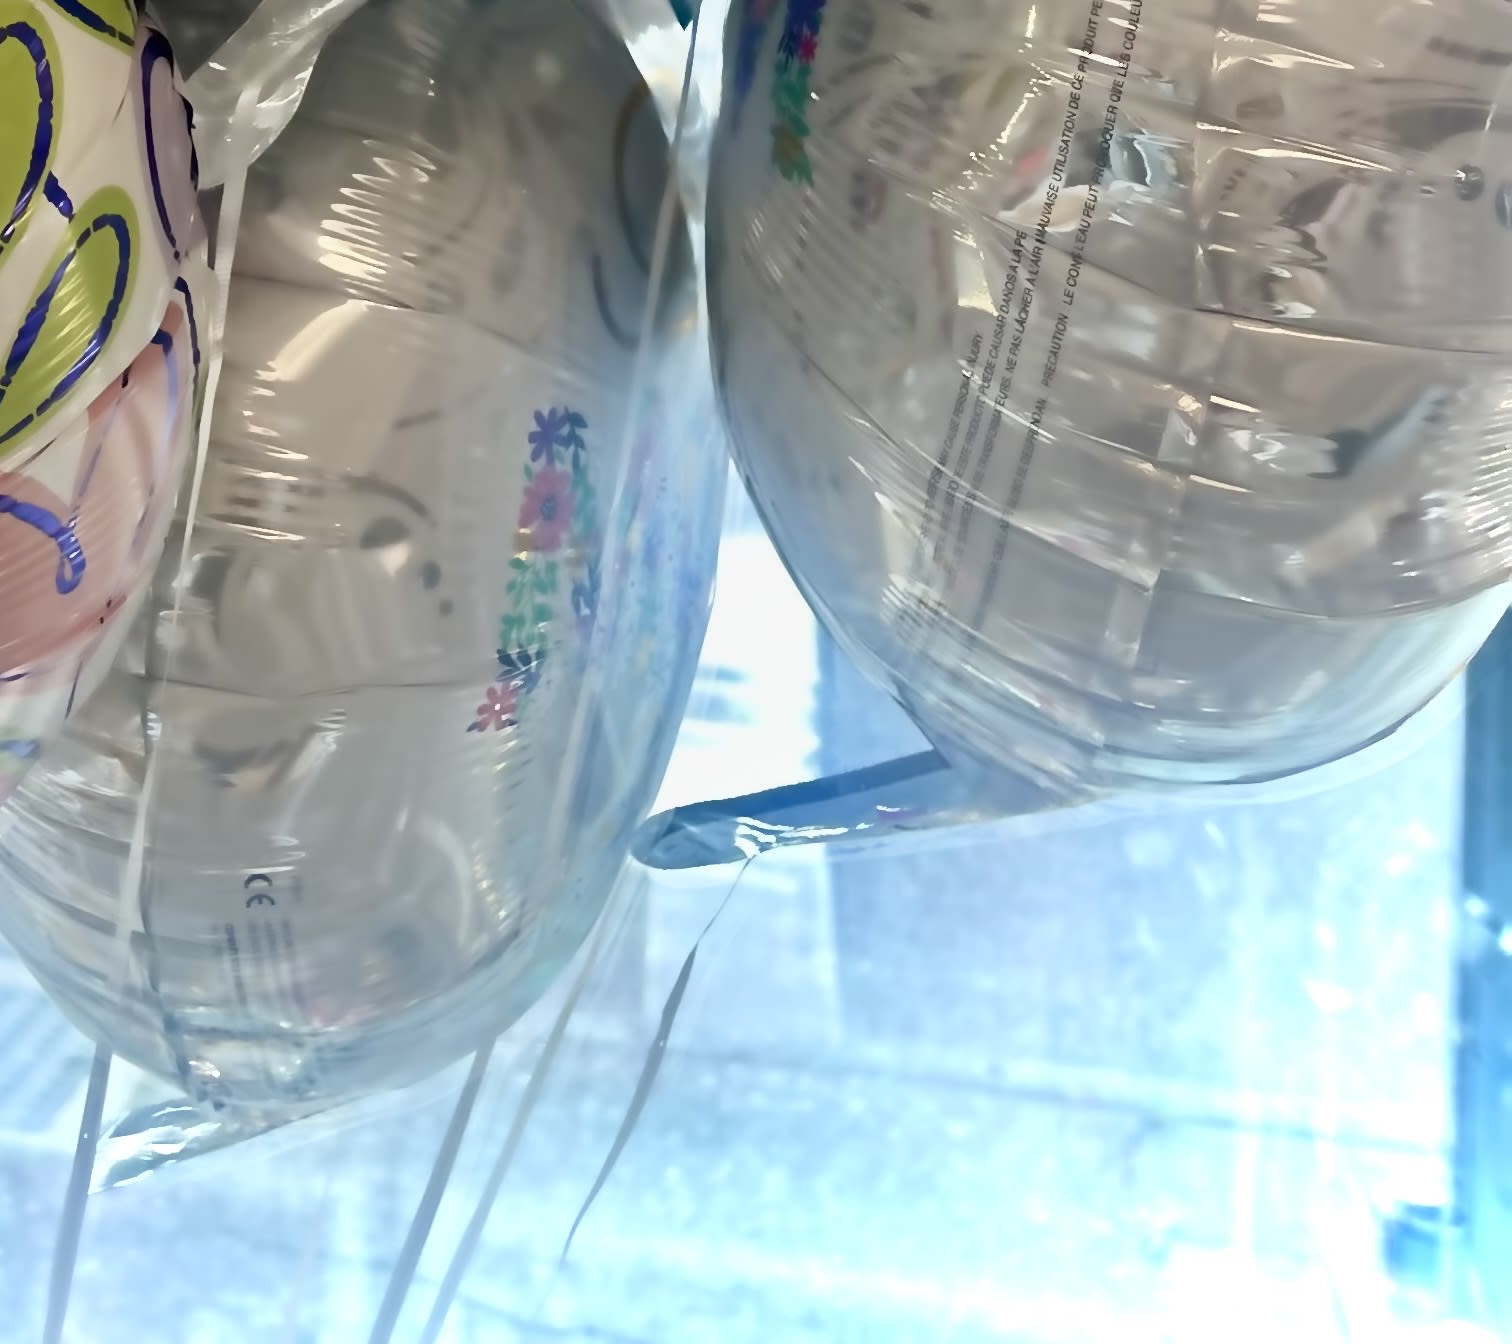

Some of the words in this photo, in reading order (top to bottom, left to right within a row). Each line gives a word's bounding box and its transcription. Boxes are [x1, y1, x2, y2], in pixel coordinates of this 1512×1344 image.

[1070, 73, 1084, 91] CE
[1067, 91, 1081, 109] DE
[1051, 111, 1077, 182] UTILISATION
[1061, 287, 1075, 305] LE
[1081, 184, 1099, 218] PEUT
[1109, 79, 1124, 102] QUE
[977, 359, 996, 395] PUEDE
[987, 314, 1007, 359] CAUSAR
[1008, 334, 1022, 356] PAS
[1004, 357, 1017, 373] NE
